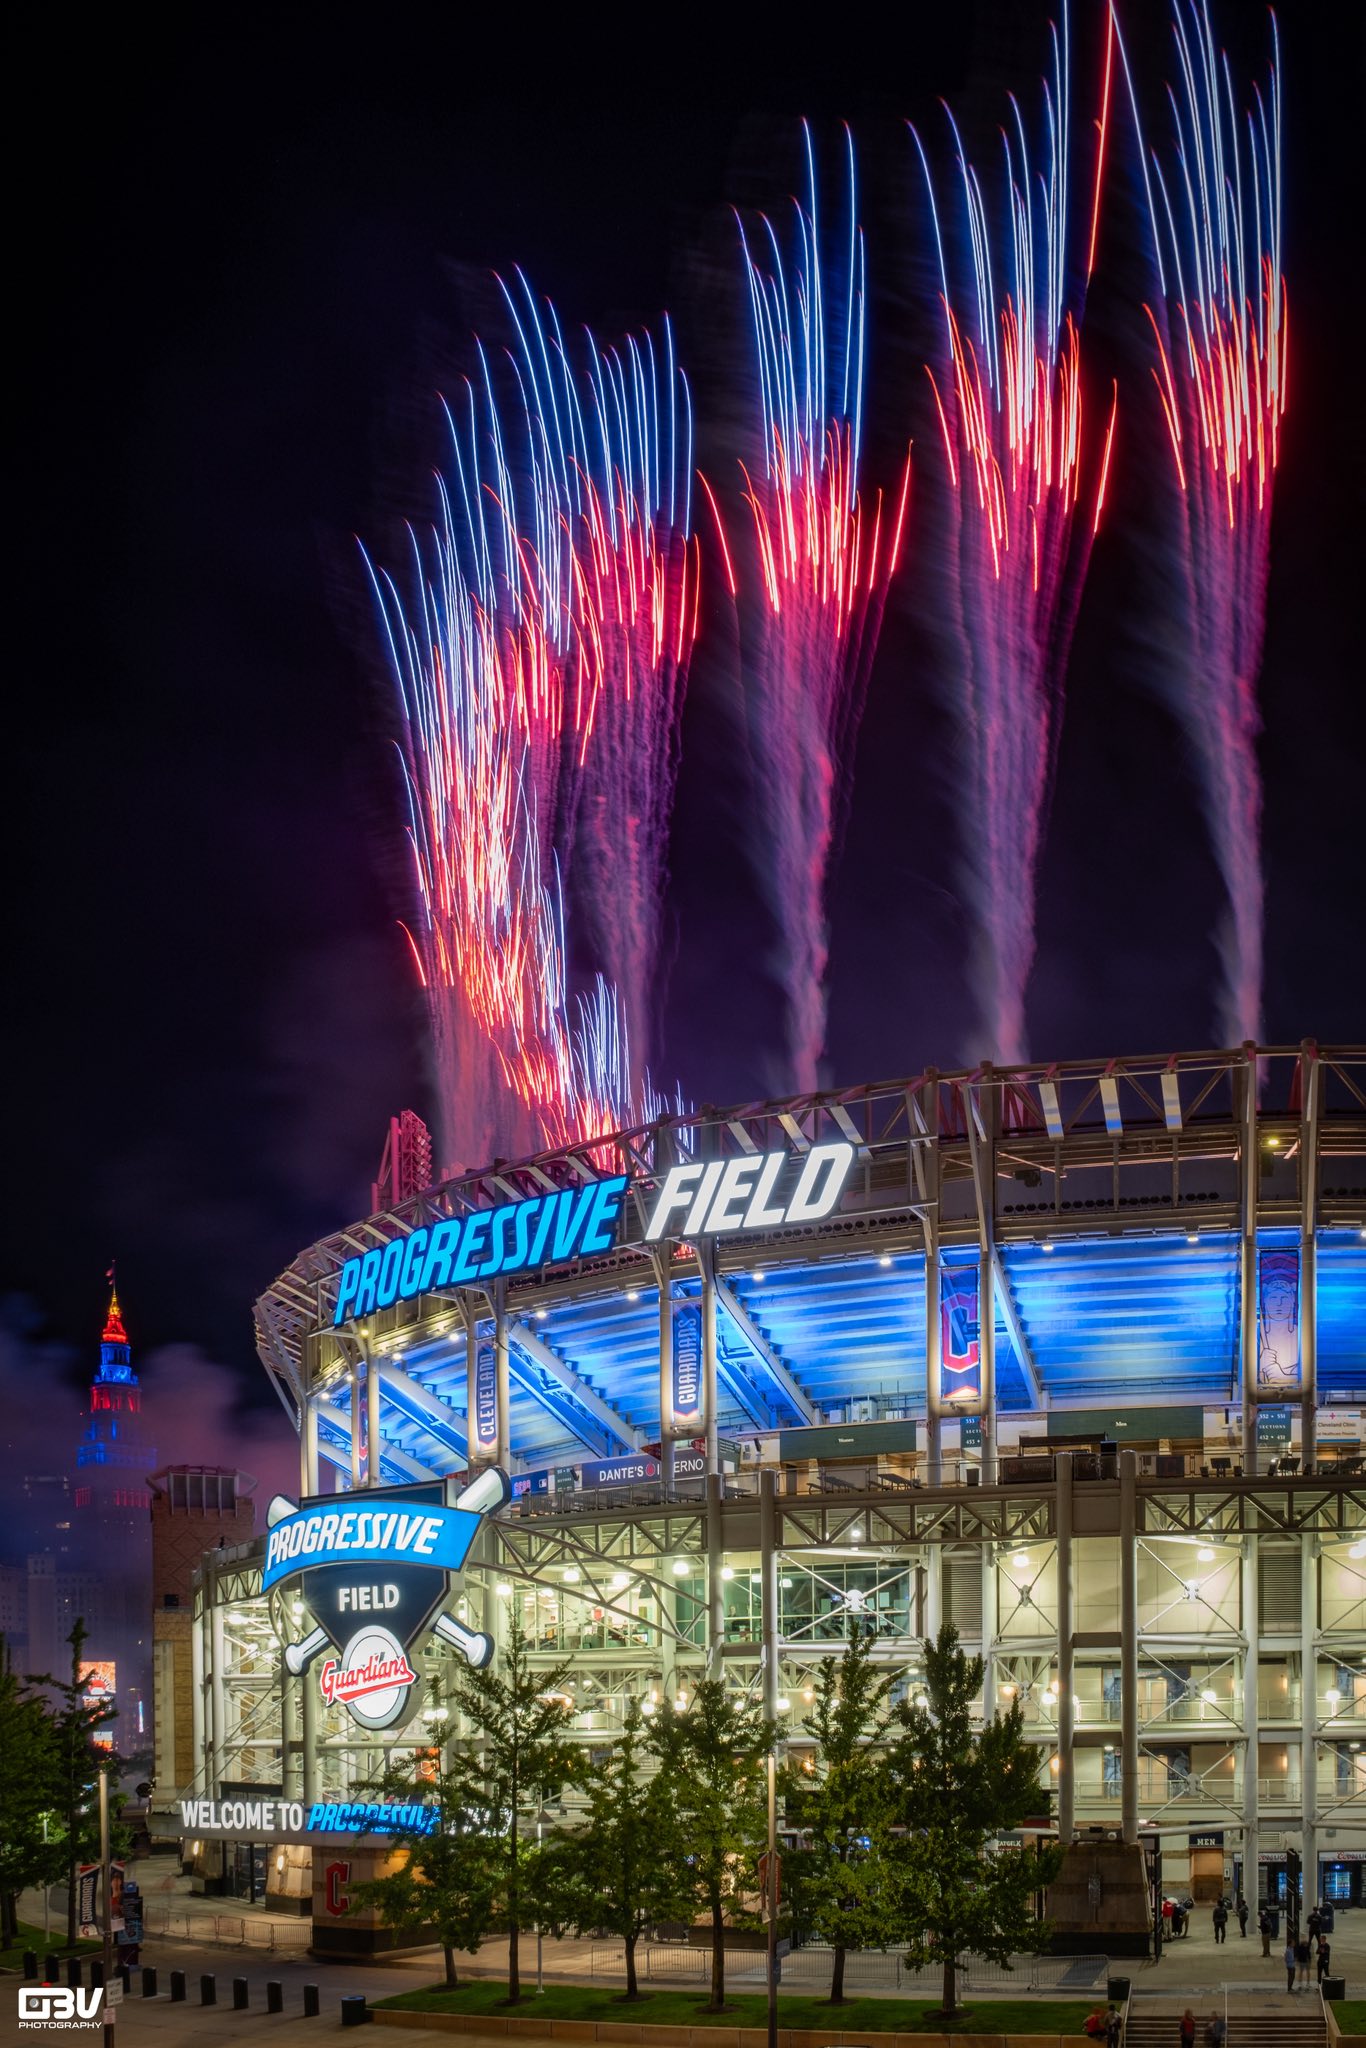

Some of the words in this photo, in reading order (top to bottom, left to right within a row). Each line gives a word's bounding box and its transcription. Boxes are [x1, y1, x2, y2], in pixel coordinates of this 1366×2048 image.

[333, 1176, 631, 1328] PROGRESSIVE
[644, 1142, 856, 1242] FIELD
[678, 1318, 697, 1404] GUARDIANS
[480, 1353, 494, 1436] CLEVELAND
[600, 1465, 644, 1482] DANTE'S
[657, 1458, 704, 1477] IERNO
[267, 1512, 444, 1571] PROGRESSIVE
[338, 1584, 401, 1612] FIELD
[320, 1654, 415, 1706] Guardians
[181, 1800, 275, 1831] WELCOME
[277, 1802, 304, 1831] TO
[1197, 1838, 1216, 1846] MEN
[82, 1877, 94, 1922] GUARDIANS
